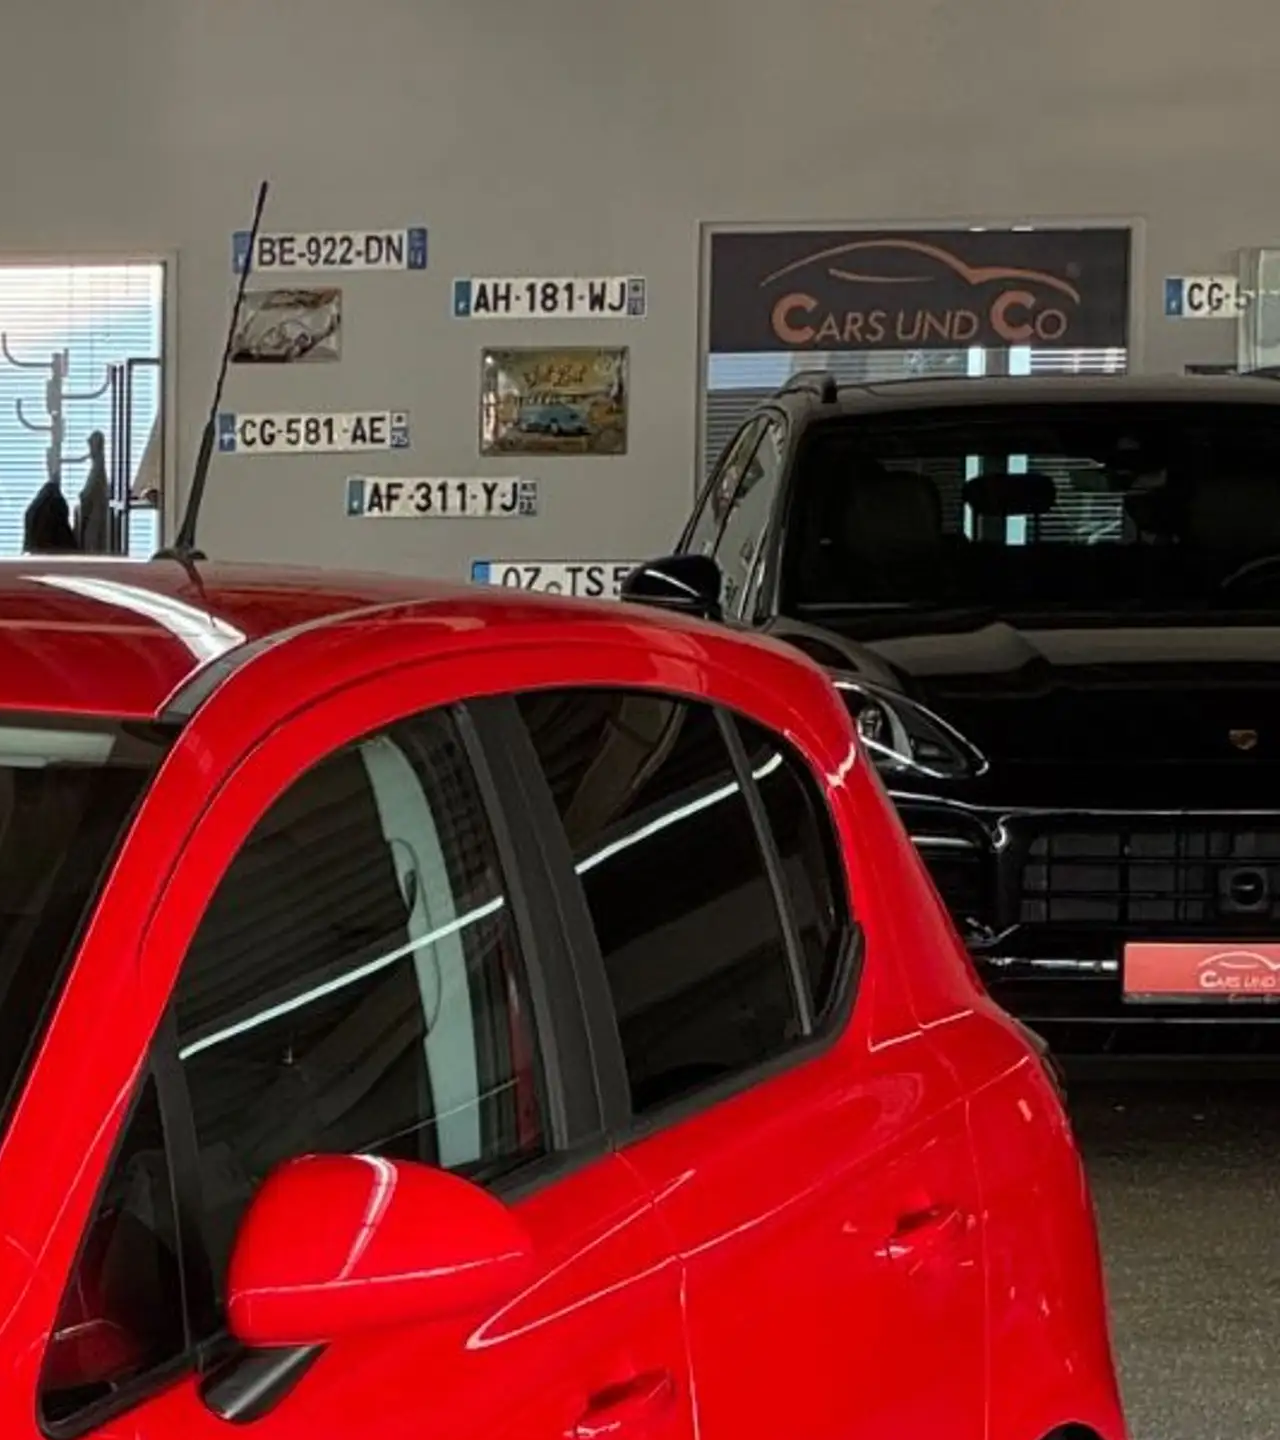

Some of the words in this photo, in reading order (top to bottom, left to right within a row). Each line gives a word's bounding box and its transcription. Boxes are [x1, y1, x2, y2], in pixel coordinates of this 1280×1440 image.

[258, 234, 404, 267] BE-922-DN
[473, 281, 627, 313] AH-181-WJ
[239, 416, 387, 447] CG-581-AE
[366, 481, 520, 513] AF-311-YJ
